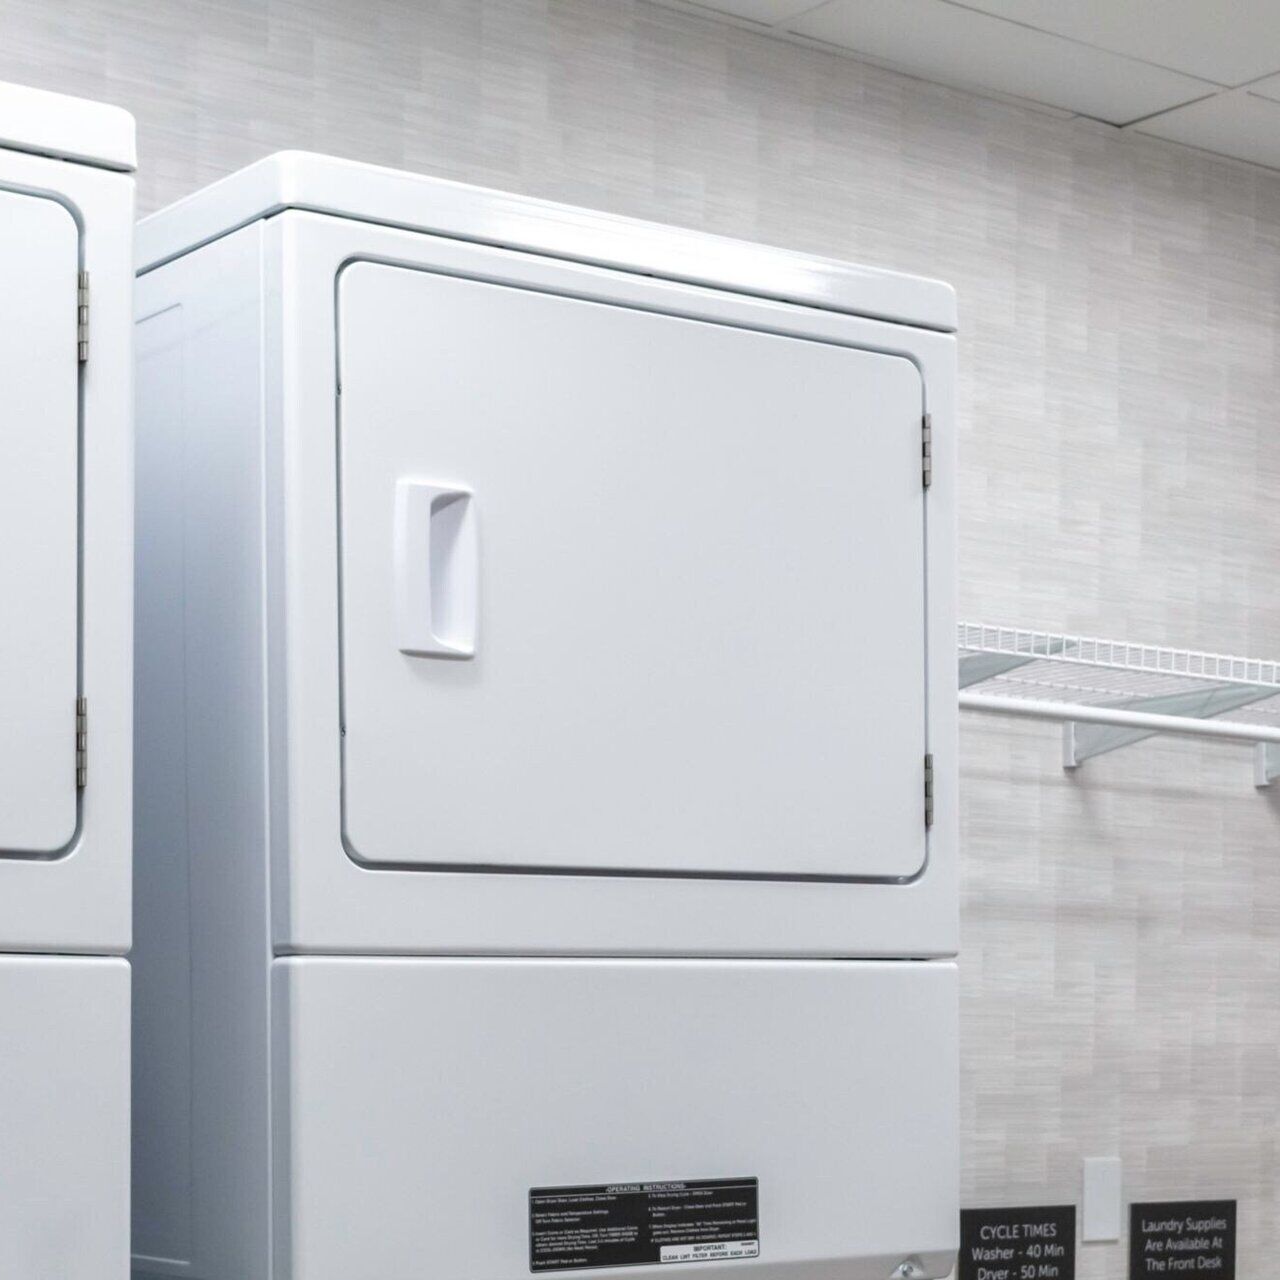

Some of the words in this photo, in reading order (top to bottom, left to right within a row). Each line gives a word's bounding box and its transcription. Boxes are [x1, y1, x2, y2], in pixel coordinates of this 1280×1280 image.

[980, 1225, 1020, 1240] CYCLE
[1022, 1223, 1057, 1238] TIMES
[1141, 1219, 1183, 1234] Laundry
[1186, 1216, 1227, 1232] Supplies
[1144, 1239, 1163, 1251] Are
[1166, 1237, 1209, 1250] Available
[1211, 1236, 1223, 1248] At
[971, 1247, 1014, 1261] Washer
[1026, 1244, 1041, 1258] 40
[1044, 1243, 1064, 1257] Min
[1145, 1258, 1165, 1271] The
[1168, 1257, 1195, 1270] Front
[1197, 1255, 1222, 1269] Desk
[1021, 1265, 1035, 1279] 50
[1038, 1264, 1058, 1278] Min
